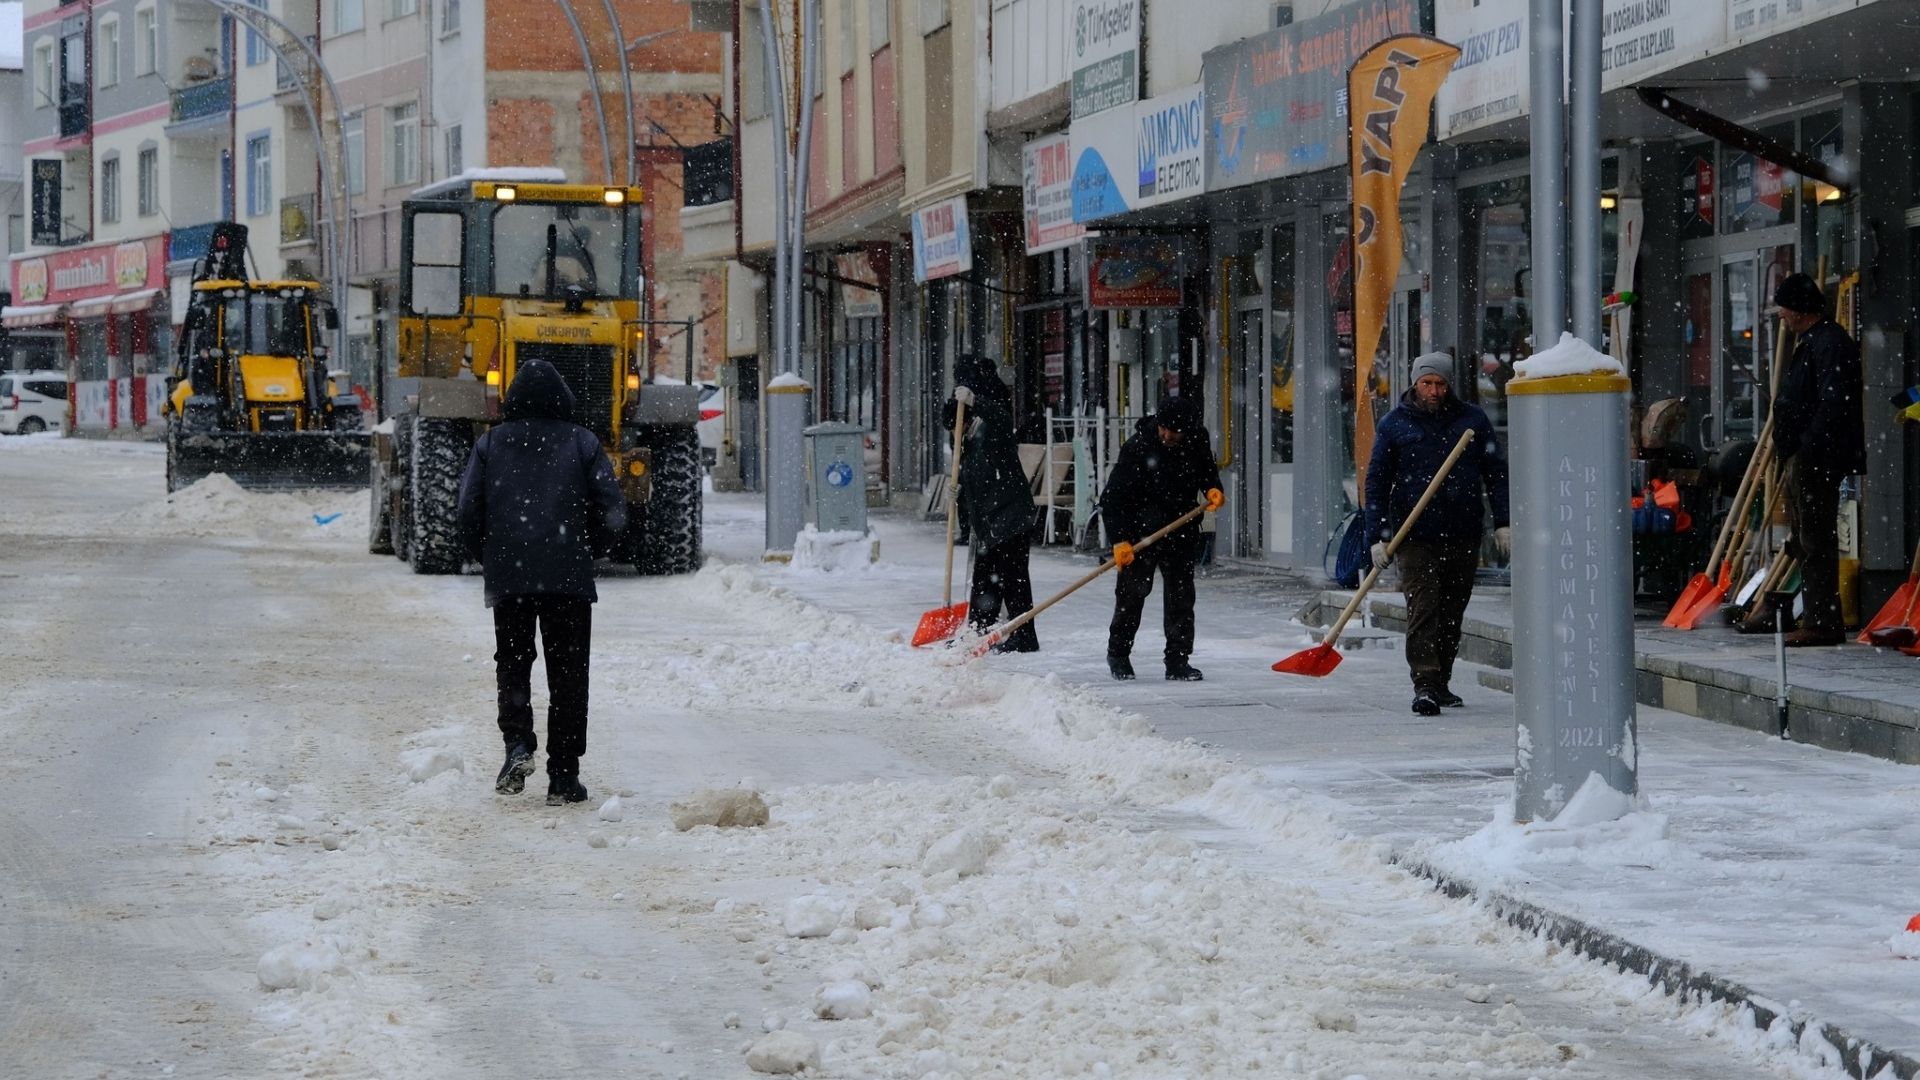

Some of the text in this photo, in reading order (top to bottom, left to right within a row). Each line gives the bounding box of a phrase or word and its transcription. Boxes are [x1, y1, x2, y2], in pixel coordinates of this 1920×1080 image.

[1087, 1, 1134, 48] Türkşeker
[1495, 18, 1523, 57] PEN
[1613, 3, 1645, 34] DOĞRAMA
[1614, 38, 1638, 68] CEPHE
[1640, 26, 1676, 59] KAPLAMA
[1156, 99, 1200, 158] MONO
[1158, 157, 1200, 194] ELECTRIC
[1559, 727, 1604, 748] 2021
